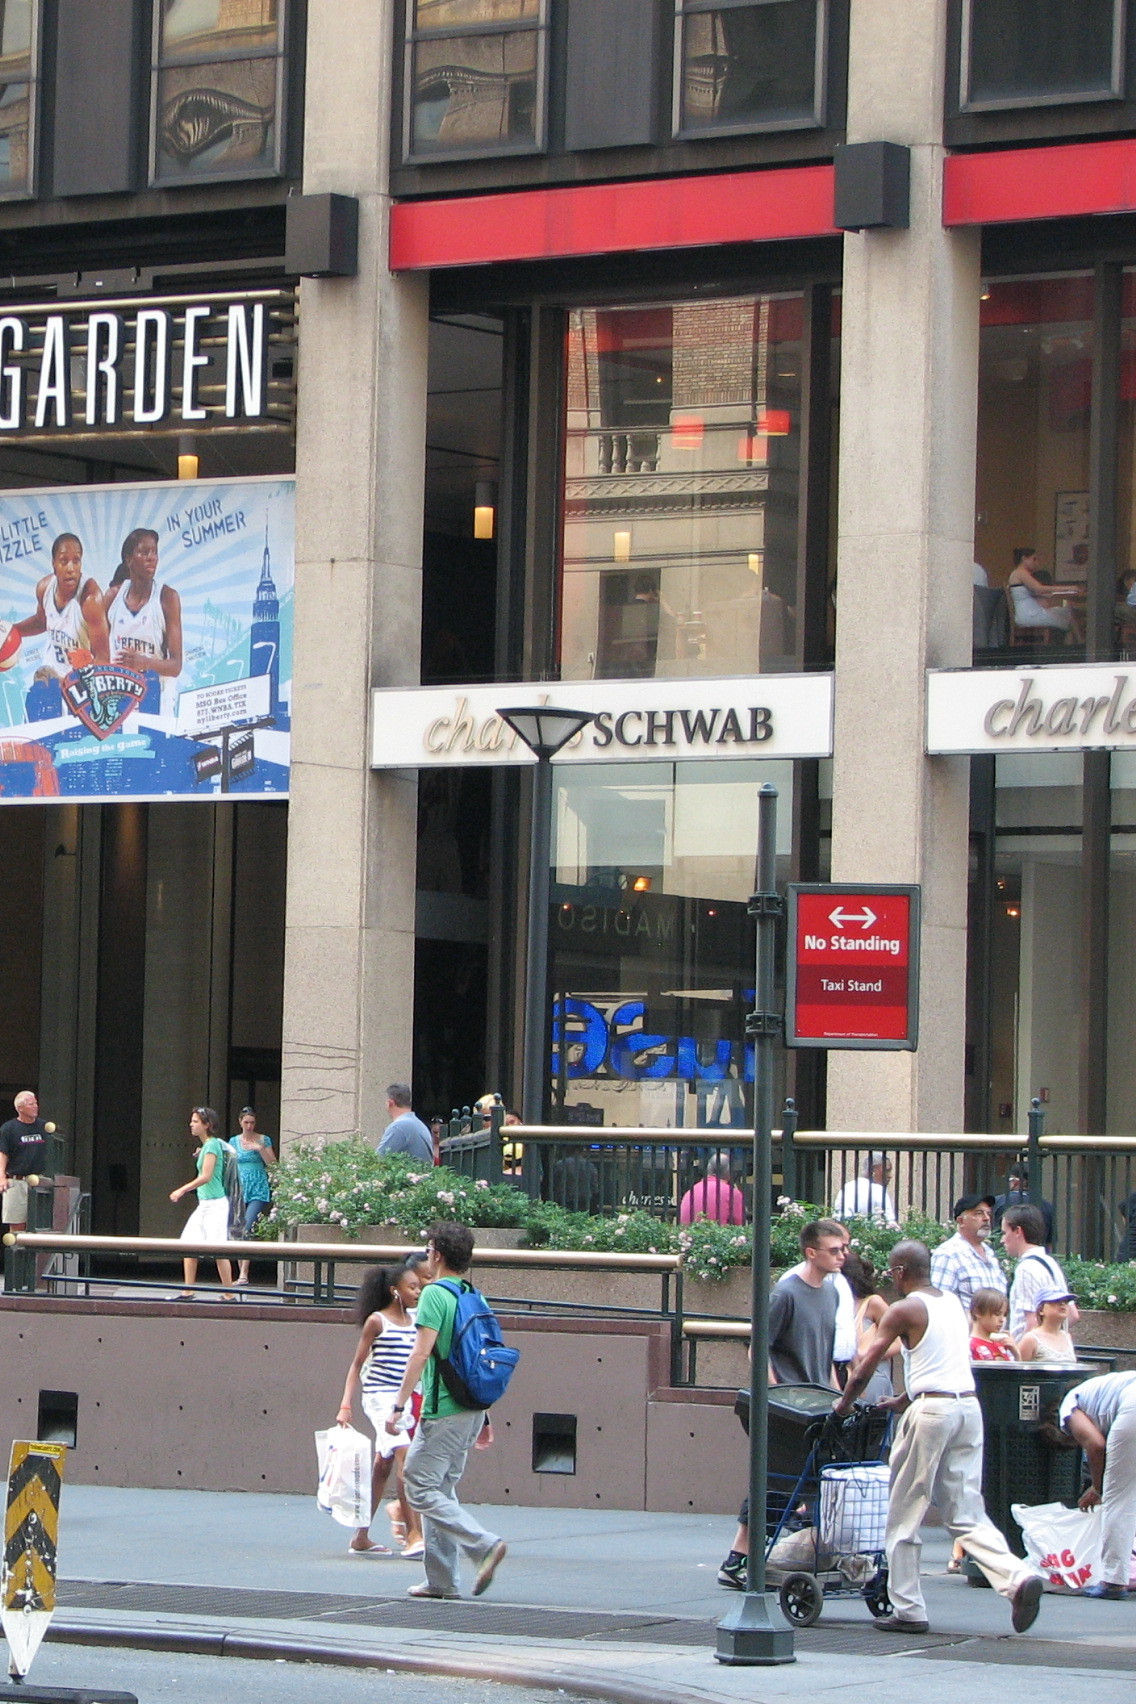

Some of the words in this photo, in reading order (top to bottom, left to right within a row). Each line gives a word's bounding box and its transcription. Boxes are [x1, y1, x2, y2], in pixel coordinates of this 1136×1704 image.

[1, 511, 49, 542] LITTLE
[166, 513, 180, 533] IN
[185, 499, 223, 523] YOUR
[182, 511, 247, 548] SUMMER
[197, 709, 247, 724] nyliberty.com
[592, 707, 774, 748] SCHWAB
[60, 745, 100, 760] Raising
[101, 743, 115, 752] the
[117, 739, 147, 752] game
[804, 935, 826, 951] No
[830, 934, 900, 955] Standing
[820, 978, 845, 992] Taxi
[847, 978, 882, 992] Stand
